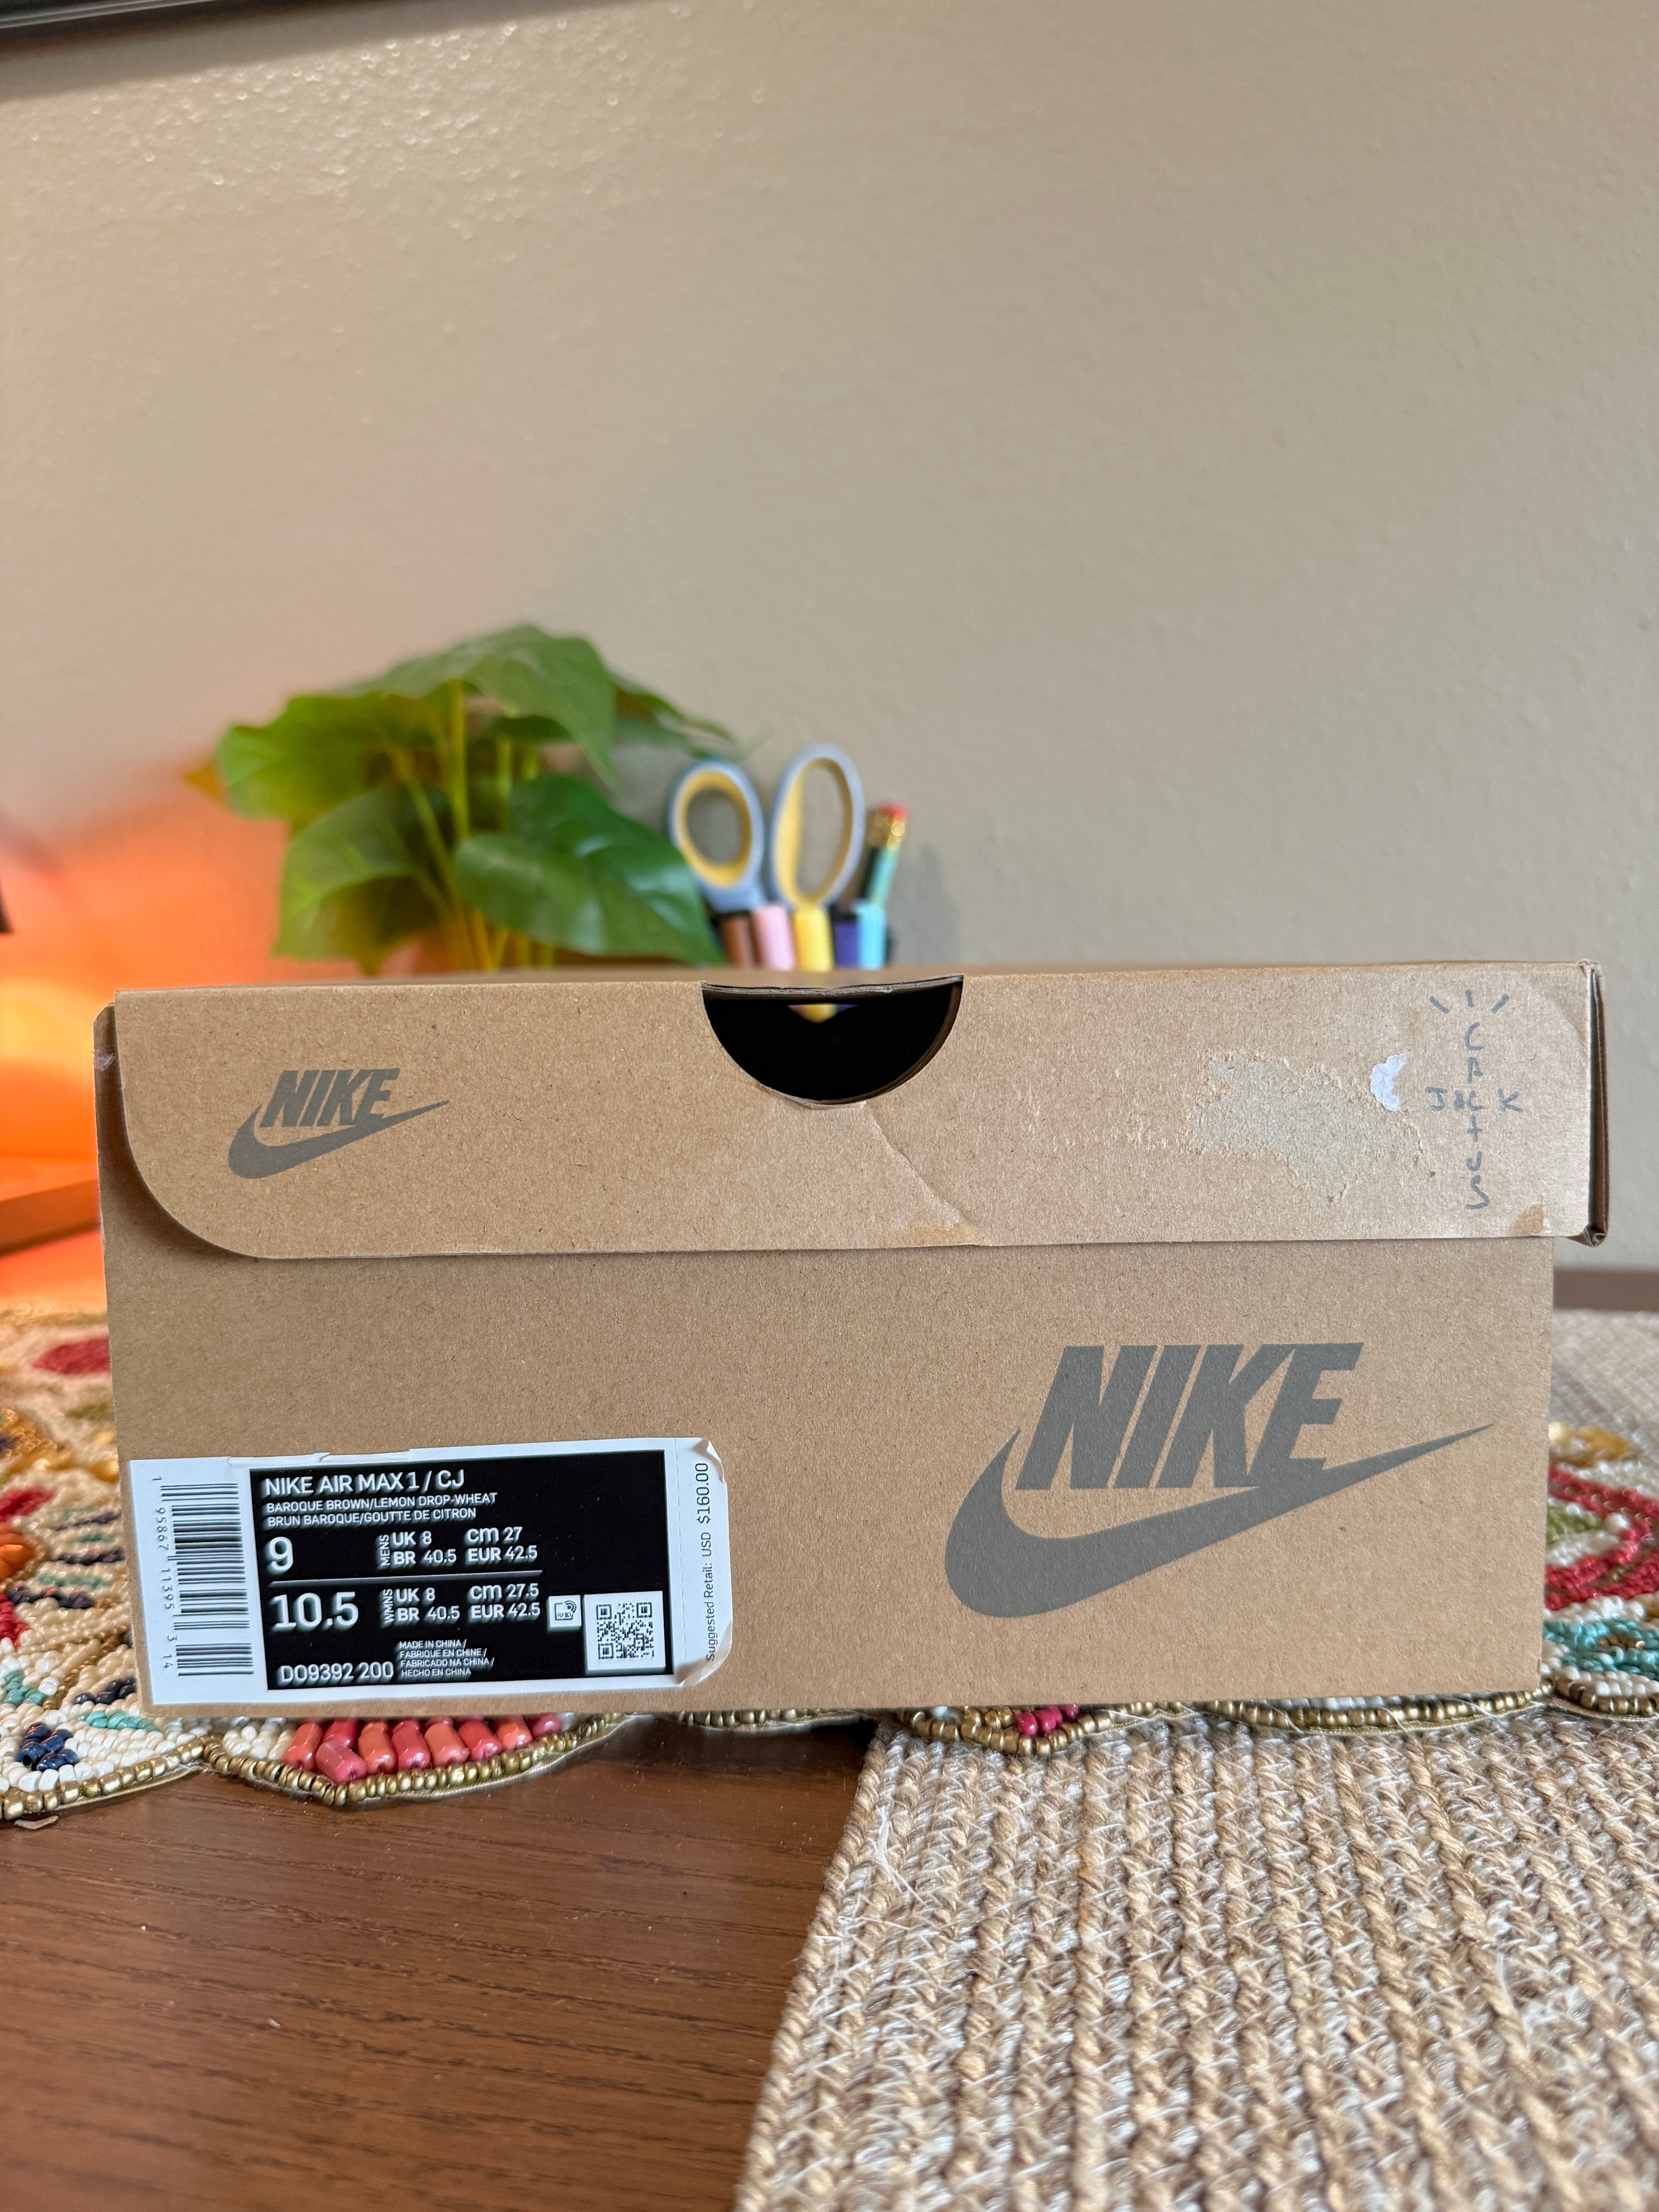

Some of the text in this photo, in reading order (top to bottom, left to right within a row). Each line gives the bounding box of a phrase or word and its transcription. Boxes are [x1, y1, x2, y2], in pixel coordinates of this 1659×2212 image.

[259, 1068, 400, 1128] NIKE
[1015, 1342, 1364, 1490] NIKE
[265, 1476, 314, 1496] NIKE
[319, 1475, 353, 1493] AIR
[358, 1472, 404, 1491] MAX
[407, 1471, 420, 1489] 1
[437, 1469, 464, 1488] CJ
[267, 1492, 498, 1513] BAROQUE BROWN/LEMON DROP-WHEAT
[268, 1508, 476, 1527] BRUN BAROQUE/GOUTTE DE CITRON
[156, 1507, 169, 1550] 95867
[466, 1527, 523, 1542] cm 27
[392, 1531, 432, 1546] UK 8
[269, 1536, 294, 1571] 9
[379, 1534, 390, 1566] MENS
[393, 1549, 457, 1565] BR 40.5
[467, 1545, 538, 1562] EUR 42.5
[695, 1463, 718, 1661] Suggested Retail: USD $160.00
[161, 1567, 174, 1610] 11395
[395, 1587, 436, 1602] UK 8
[469, 1583, 539, 1600] cm 27.5
[270, 1592, 359, 1628] 10.5
[383, 1588, 395, 1623] WMNS
[397, 1606, 460, 1622] BR 40.5
[471, 1602, 541, 1619] EUR 42.5
[399, 1640, 424, 1649] MADE
[425, 1640, 434, 1648] IN
[163, 1653, 174, 1668] 14
[400, 1649, 441, 1659] FABRIQUE
[443, 1649, 455, 1657] EN
[359, 1661, 394, 1679] 200
[400, 1658, 448, 1668] FABRICADO
[449, 1658, 462, 1667] NA
[402, 1667, 472, 1678] HECHO EN CHINA
